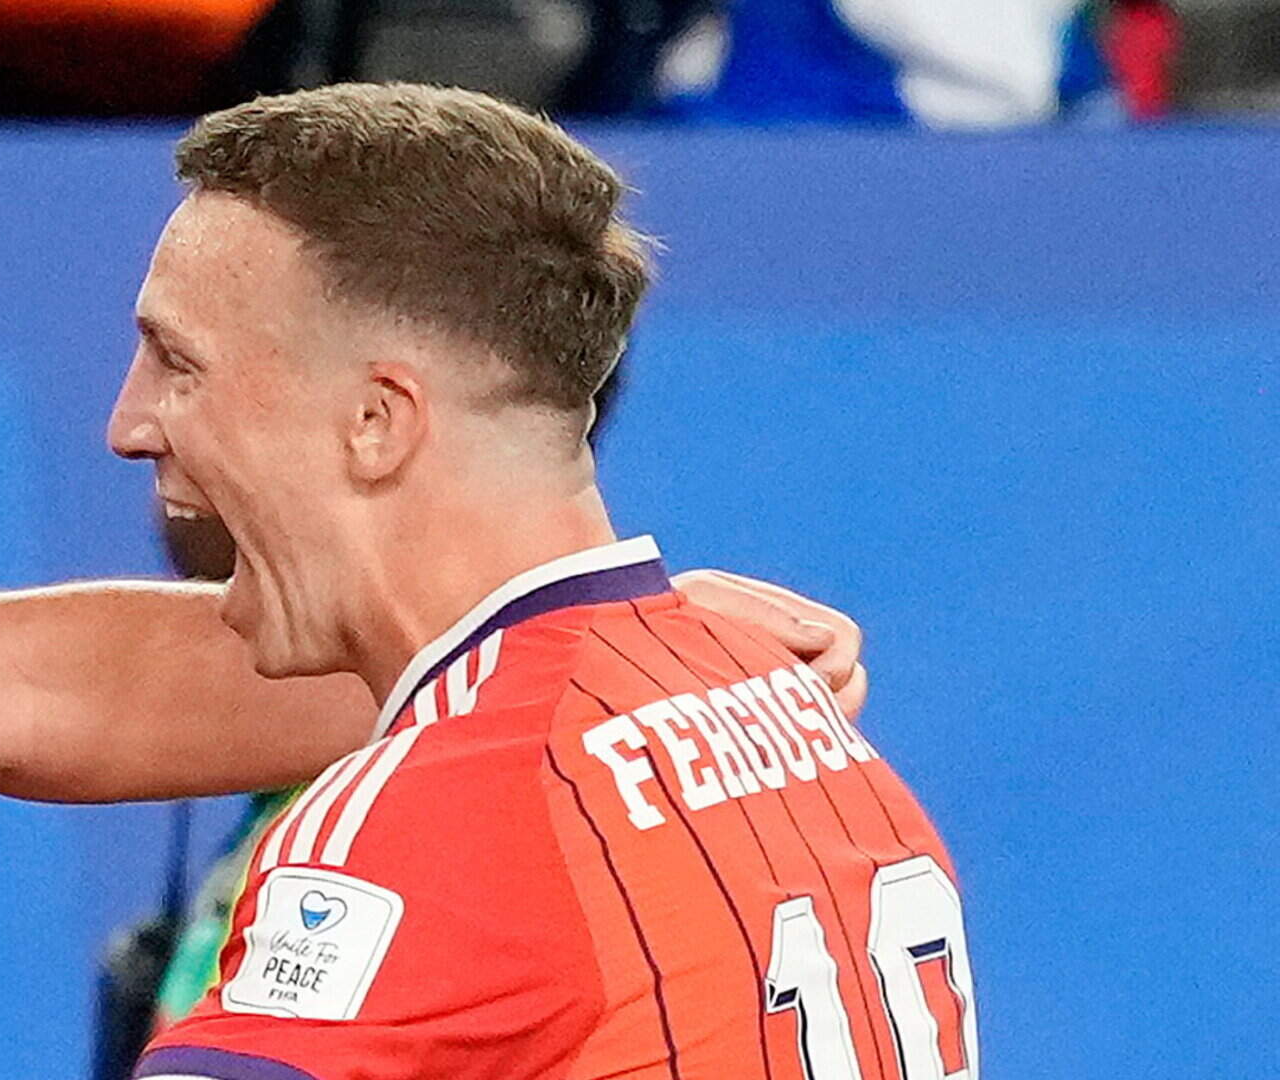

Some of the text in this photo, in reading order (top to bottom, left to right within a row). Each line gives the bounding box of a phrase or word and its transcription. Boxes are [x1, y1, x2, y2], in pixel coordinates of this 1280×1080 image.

[581, 662, 881, 831] FERGUSO
[269, 929, 339, 965] Unite For
[262, 956, 328, 993] PEACE
